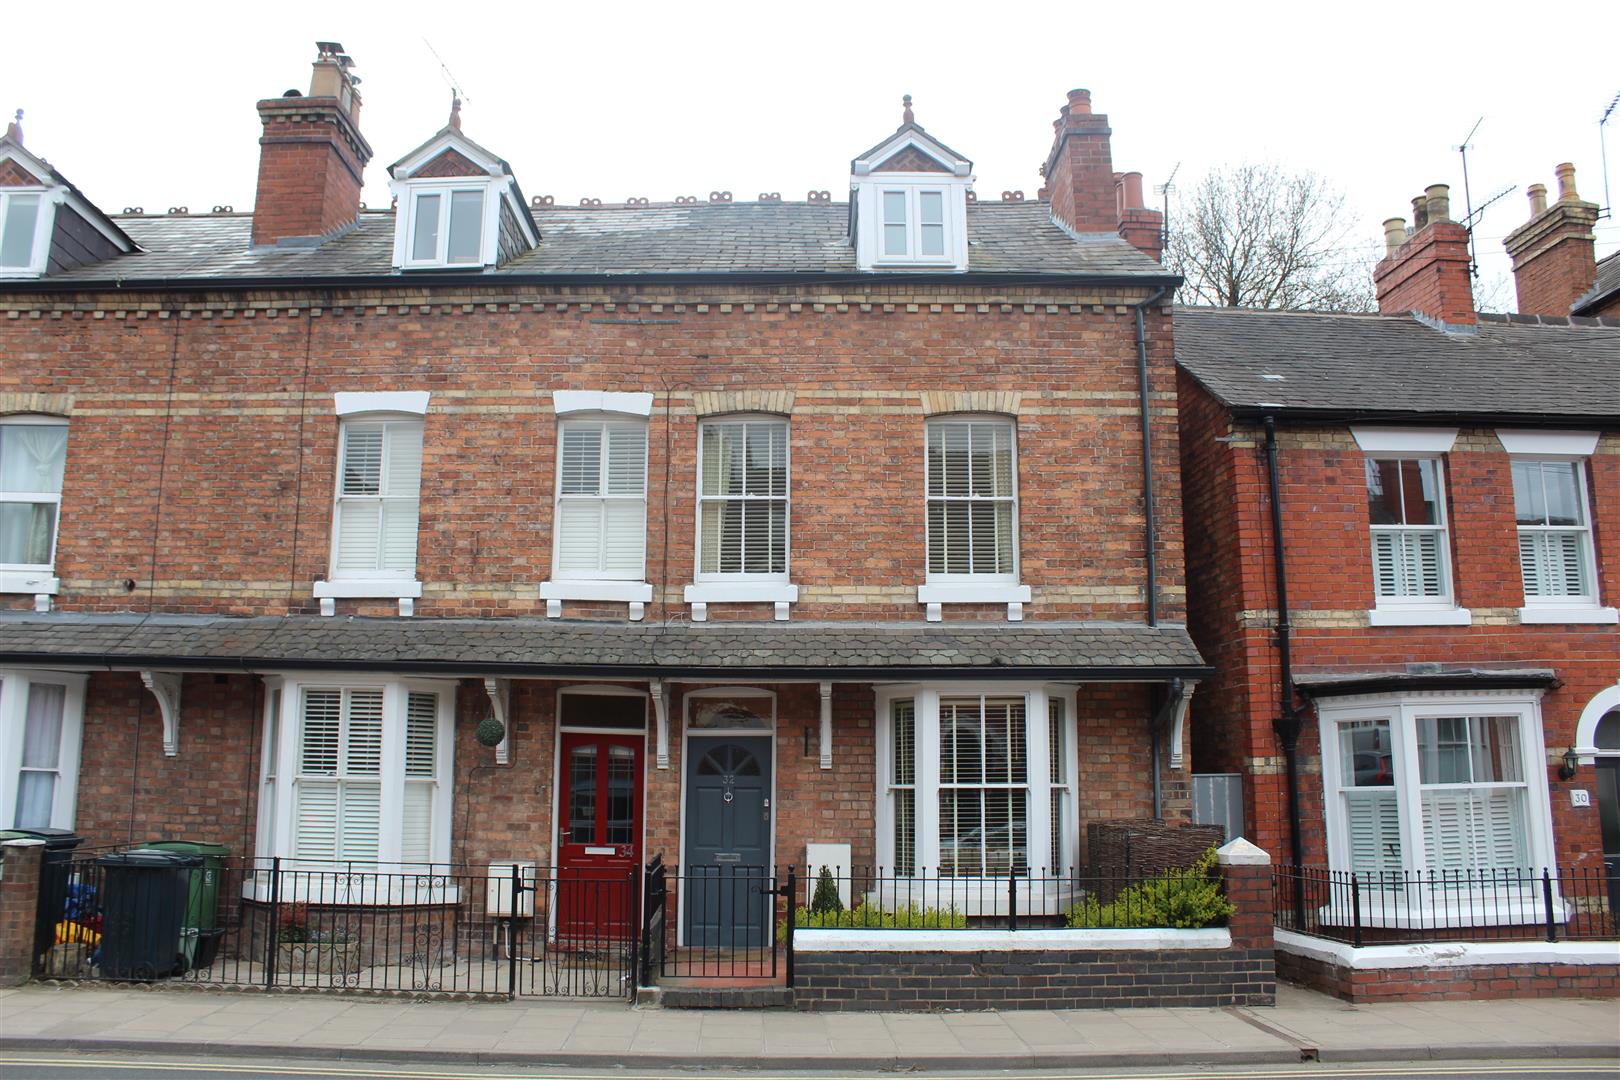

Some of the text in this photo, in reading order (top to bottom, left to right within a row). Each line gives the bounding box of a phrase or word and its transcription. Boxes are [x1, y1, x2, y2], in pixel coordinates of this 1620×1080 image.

[722, 775, 735, 784] 32
[1575, 793, 1588, 803] 30
[618, 845, 634, 858] 34
